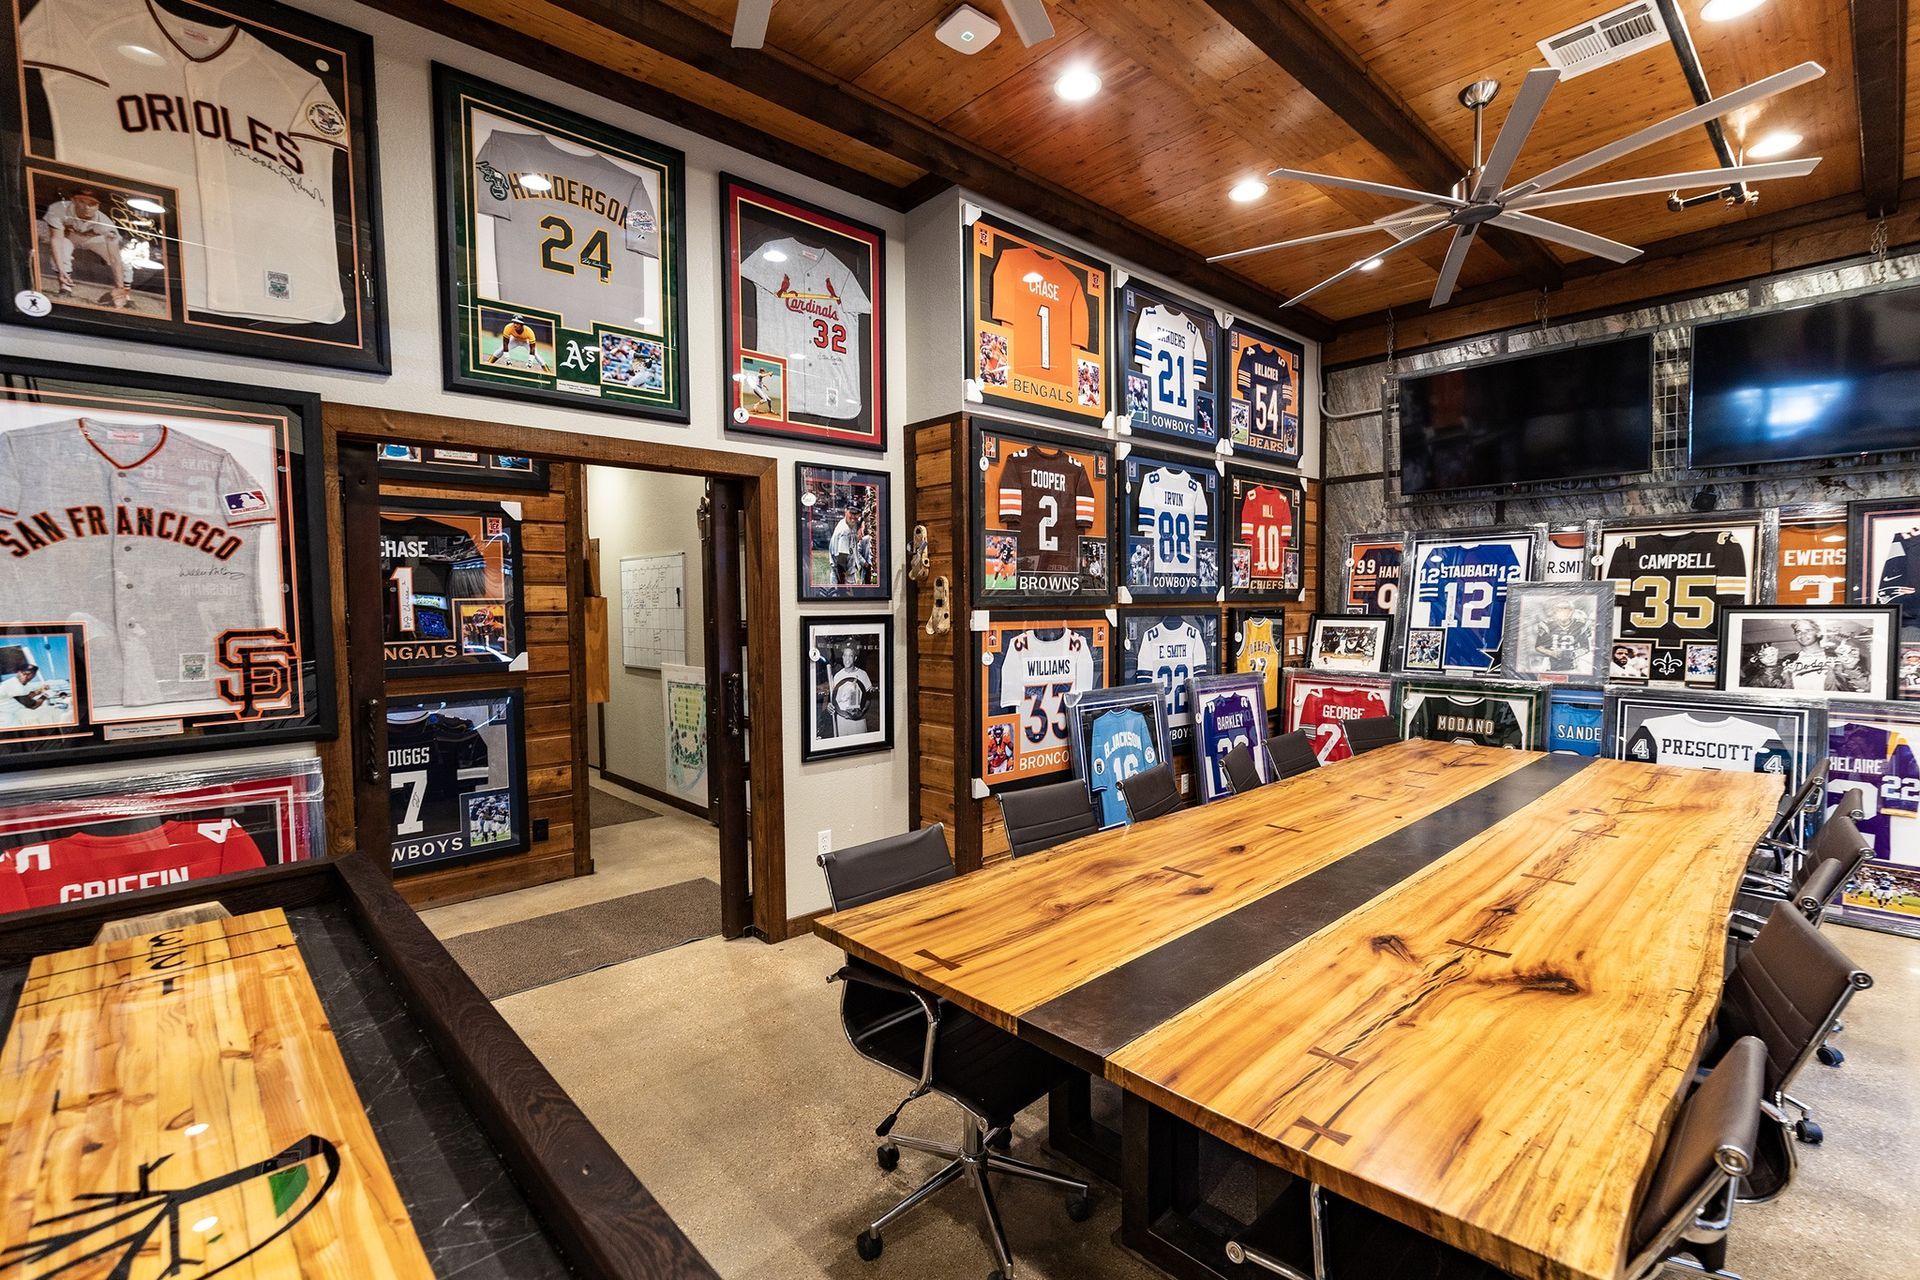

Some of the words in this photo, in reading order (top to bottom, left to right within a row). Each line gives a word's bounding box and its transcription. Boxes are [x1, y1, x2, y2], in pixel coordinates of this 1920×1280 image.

[117, 93, 304, 175] ORIOLES
[539, 215, 612, 284] 24
[1028, 279, 1060, 302] CHASE
[784, 291, 840, 322] Cardinals
[813, 318, 847, 354] 32
[1037, 305, 1051, 370] 1
[1013, 378, 1074, 404] BENGALS
[1158, 350, 1187, 408] 21
[1255, 384, 1279, 434] 54
[1151, 414, 1196, 435] COWBOYS
[1249, 435, 1285, 454] BEARS
[1031, 468, 1066, 492] COOPER
[1164, 491, 1184, 507] IRVIN
[0, 513, 70, 558] SAN
[67, 505, 244, 562] FRANCISCO
[1038, 495, 1059, 551] 2
[1158, 511, 1192, 564] 88
[1254, 525, 1279, 571] 10
[1356, 559, 1376, 574] 99
[1638, 552, 1717, 570] CAMPBELL
[1783, 548, 1847, 567] EWERS
[1019, 576, 1080, 591] BROWNS
[1152, 575, 1198, 589] COWBOYS
[1441, 563, 1497, 579] STAUBACH
[1497, 566, 1521, 583] 12
[1250, 580, 1285, 591] CHIEFS
[389, 566, 416, 632] 1
[1441, 581, 1493, 628] 12
[1629, 575, 1718, 630] 35
[1159, 645, 1166, 659] E.
[1167, 644, 1187, 658] SMITH
[214, 627, 300, 720] SF
[1027, 658, 1071, 677] WILLIAMS
[1023, 681, 1073, 744] 33
[1216, 711, 1244, 731] BARKLEY
[1169, 727, 1192, 741] BOY
[1436, 714, 1495, 736] MODANO
[1557, 724, 1602, 741] SANDE
[388, 746, 430, 767] DIGGS
[1019, 750, 1072, 772] BRONCO
[1631, 739, 1650, 760] 4
[1661, 739, 1753, 763] PRESCOTT
[1880, 775, 1920, 802] 22
[391, 769, 428, 836] 7
